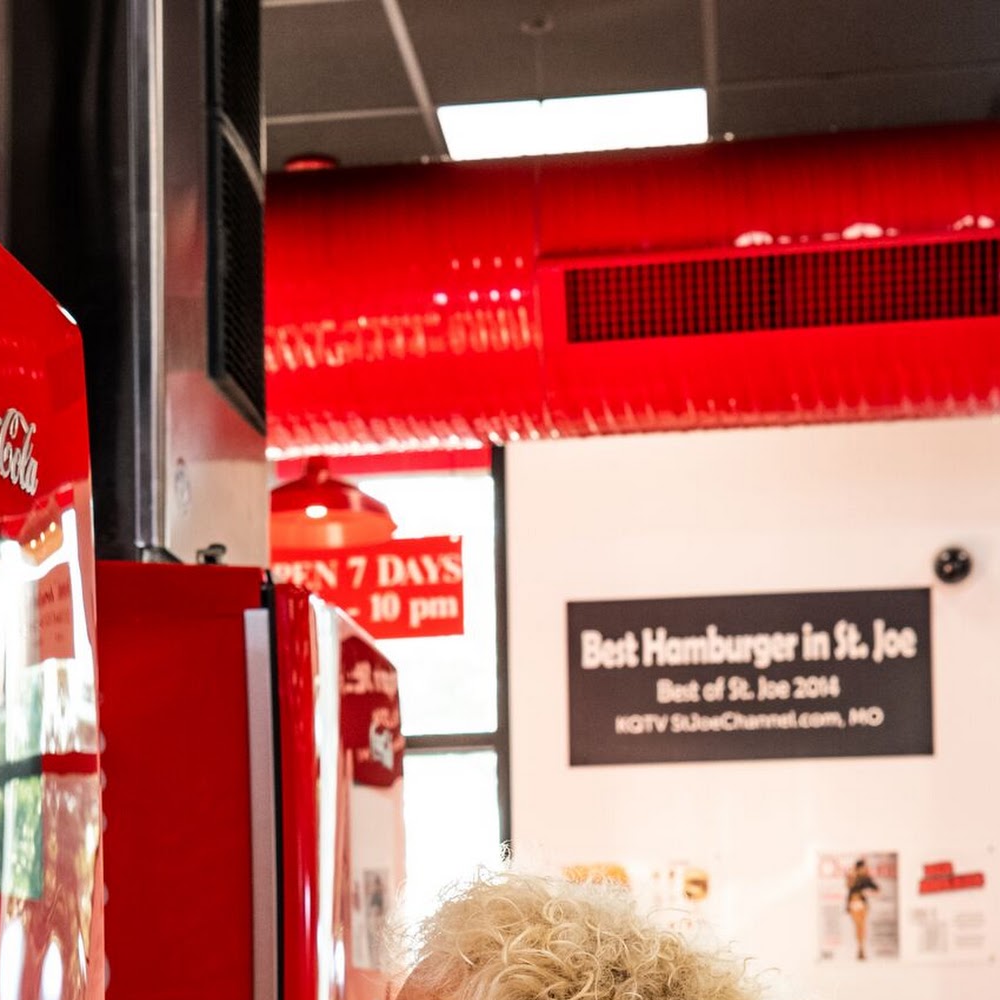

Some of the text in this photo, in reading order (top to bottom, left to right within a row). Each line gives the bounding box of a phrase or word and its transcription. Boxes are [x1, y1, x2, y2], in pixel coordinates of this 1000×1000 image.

[271, 551, 462, 590] PEN 7 DAYS
[369, 590, 400, 622] 10
[409, 596, 459, 628] pm
[580, 618, 918, 669] Best Hamburger in St. Joe
[656, 674, 841, 704] Best of St. Joe 2014
[848, 705, 885, 727] MO
